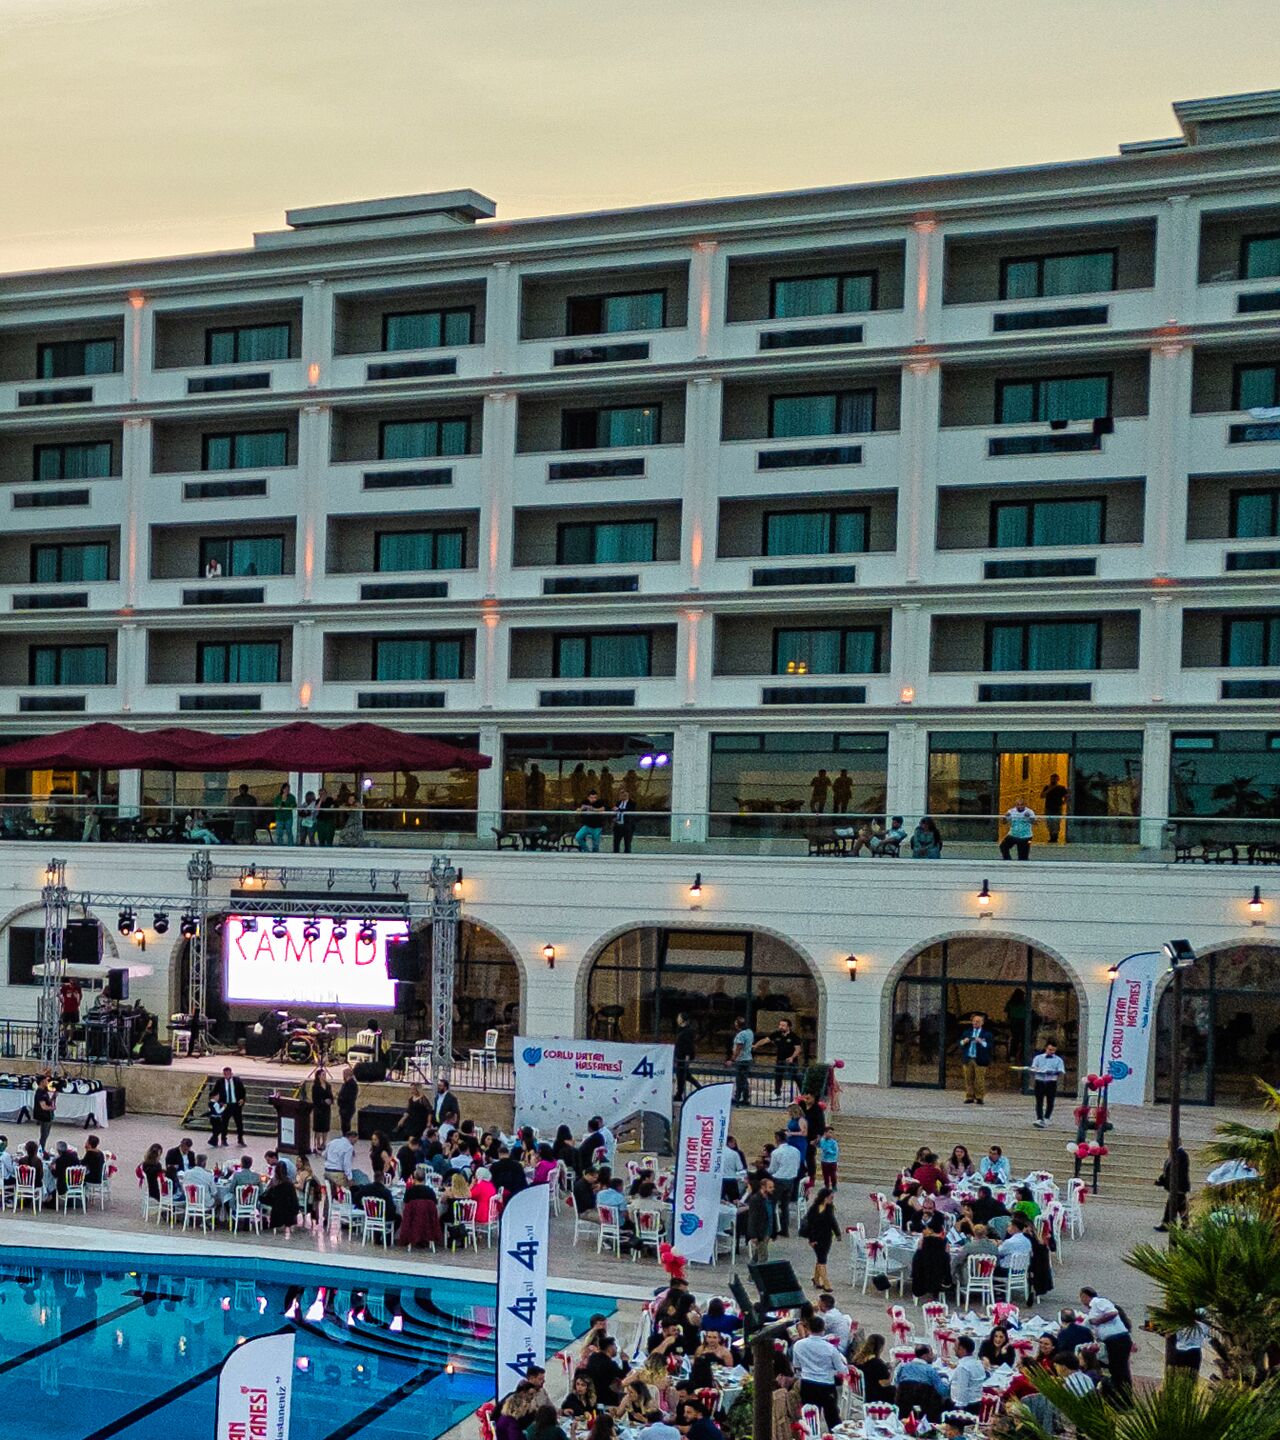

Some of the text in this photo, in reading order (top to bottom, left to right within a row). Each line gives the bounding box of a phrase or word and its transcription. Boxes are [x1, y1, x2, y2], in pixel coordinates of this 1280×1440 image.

[1115, 997, 1127, 1027] VATAN
[1126, 979, 1141, 1028] HASTANESİ
[576, 1052, 605, 1062] VATAN
[576, 1060, 623, 1073] HASTANESİ
[685, 1137, 699, 1171] VATAN
[696, 1115, 714, 1172] HASTANESİ
